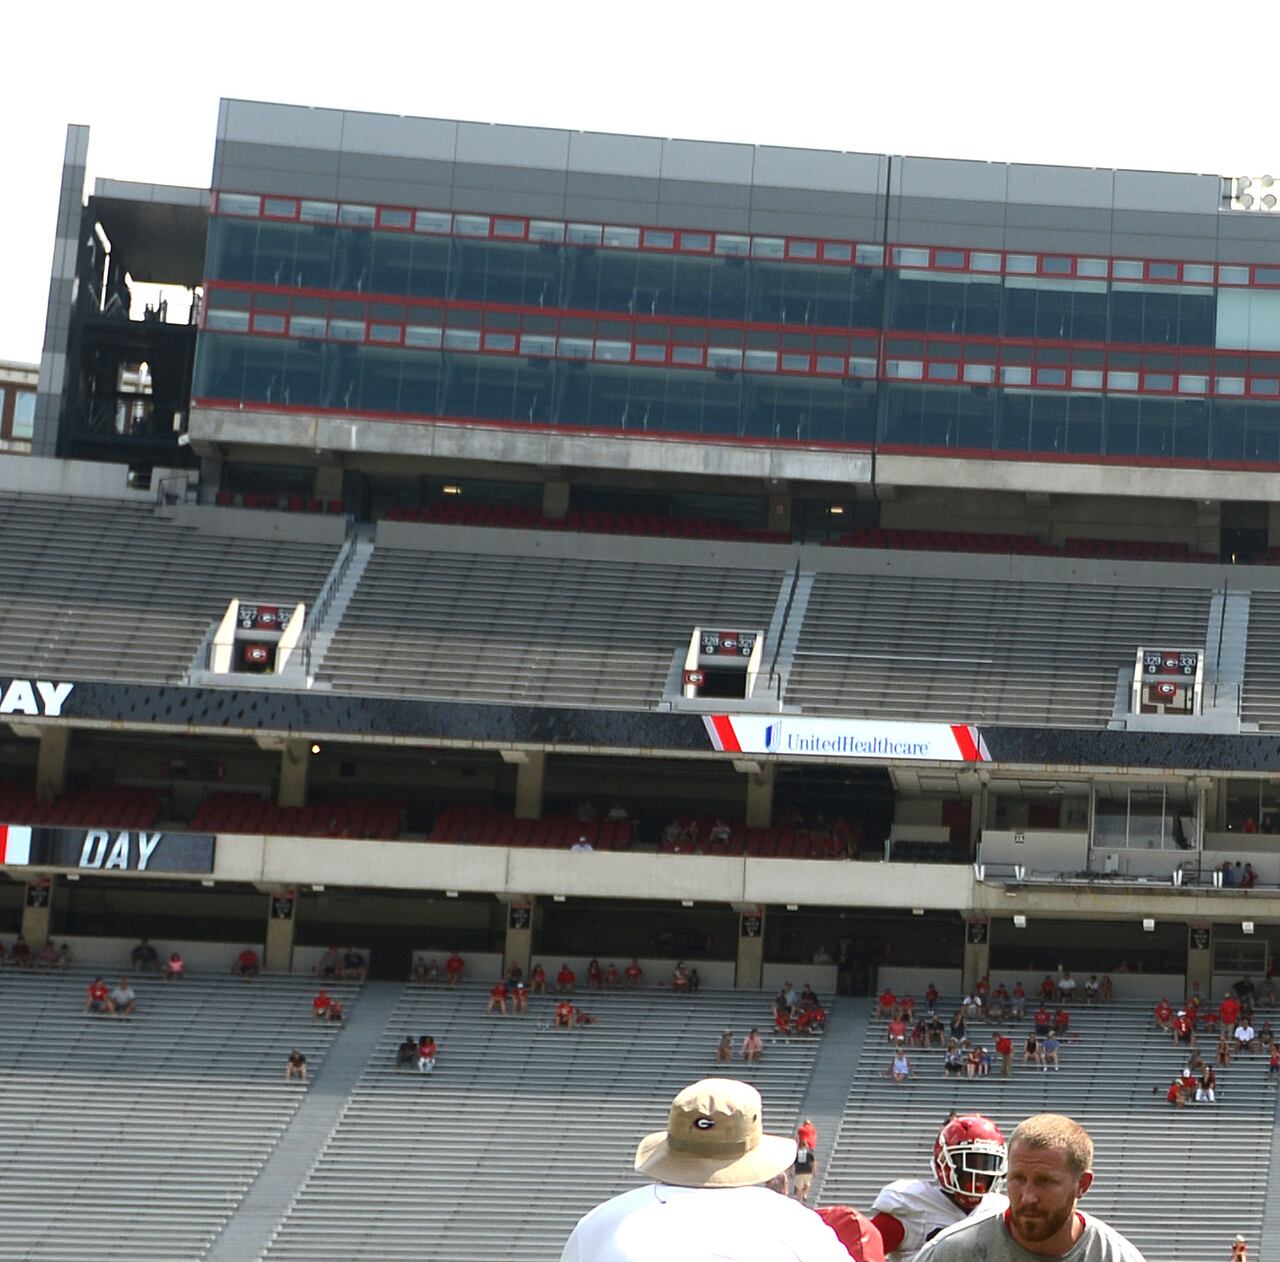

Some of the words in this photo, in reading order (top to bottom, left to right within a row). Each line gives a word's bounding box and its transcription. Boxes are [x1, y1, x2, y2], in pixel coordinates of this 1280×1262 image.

[0, 680, 74, 716] AY
[787, 733, 929, 755] UnitedHealthcare
[79, 829, 162, 871] DAY
